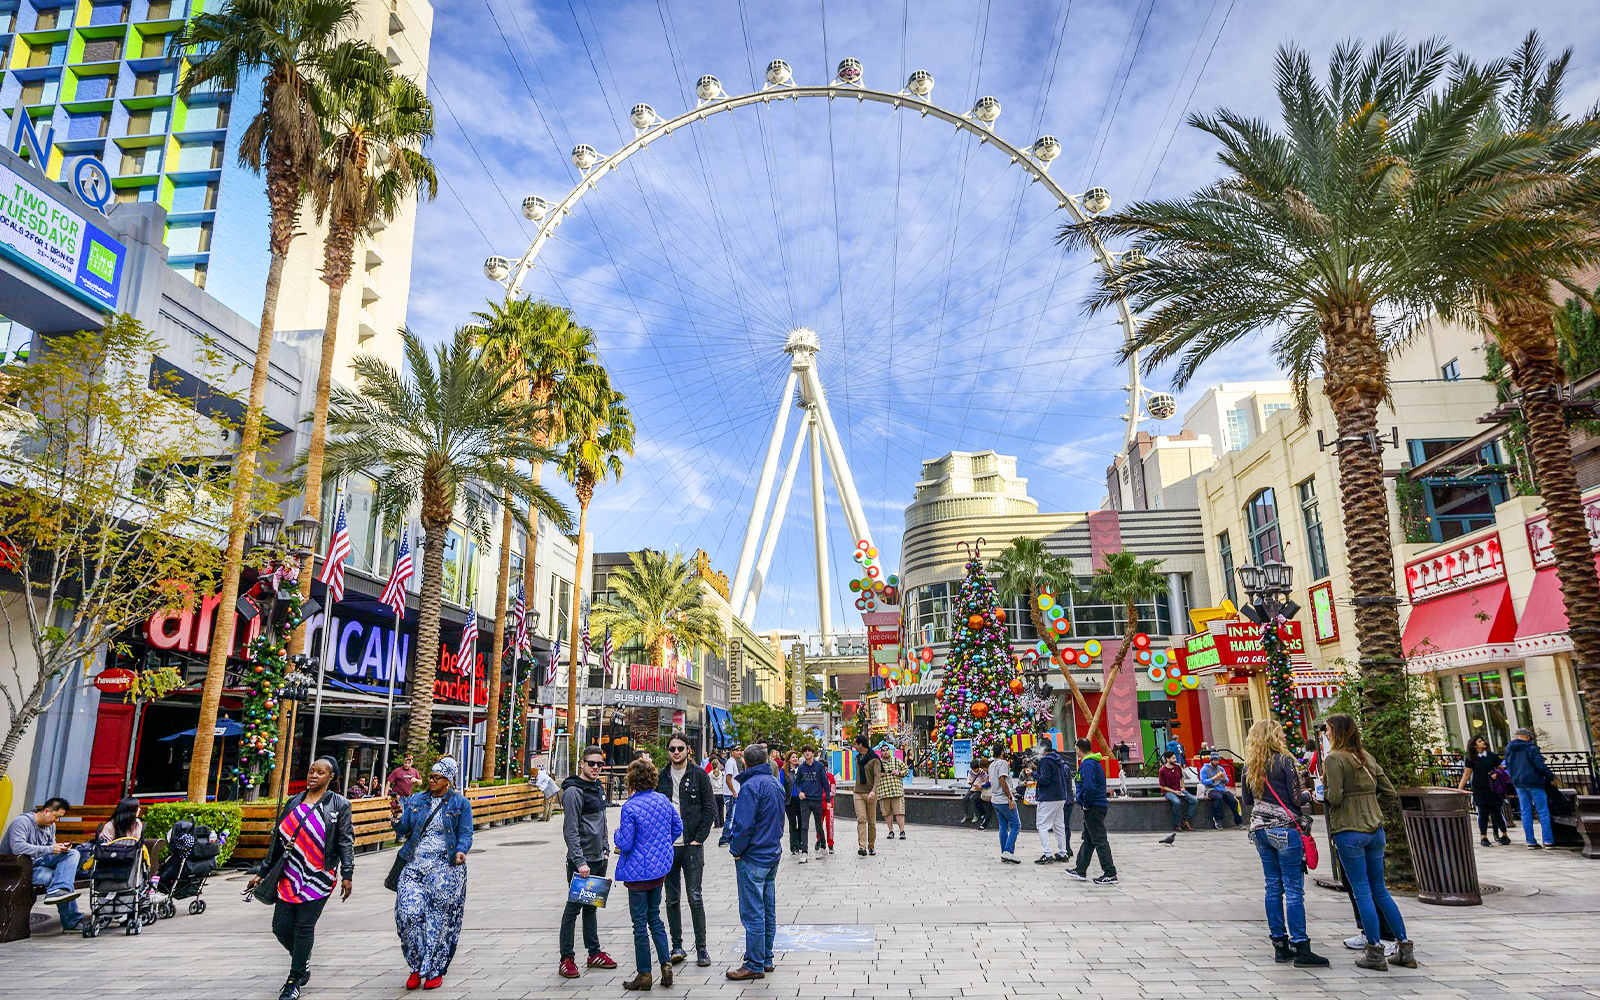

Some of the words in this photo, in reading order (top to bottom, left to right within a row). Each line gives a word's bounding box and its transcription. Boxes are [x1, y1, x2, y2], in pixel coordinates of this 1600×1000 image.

[0, 194, 76, 254] TUESDAYS
[15, 183, 48, 217] TWO
[51, 208, 79, 239] FOR
[475, 653, 485, 679] &
[730, 640, 741, 700] Ghirardelli
[1237, 656, 1249, 664] NO
[433, 675, 489, 706] cocktils
[614, 693, 643, 703] SUSHI
[645, 695, 676, 705] BURRITOS
